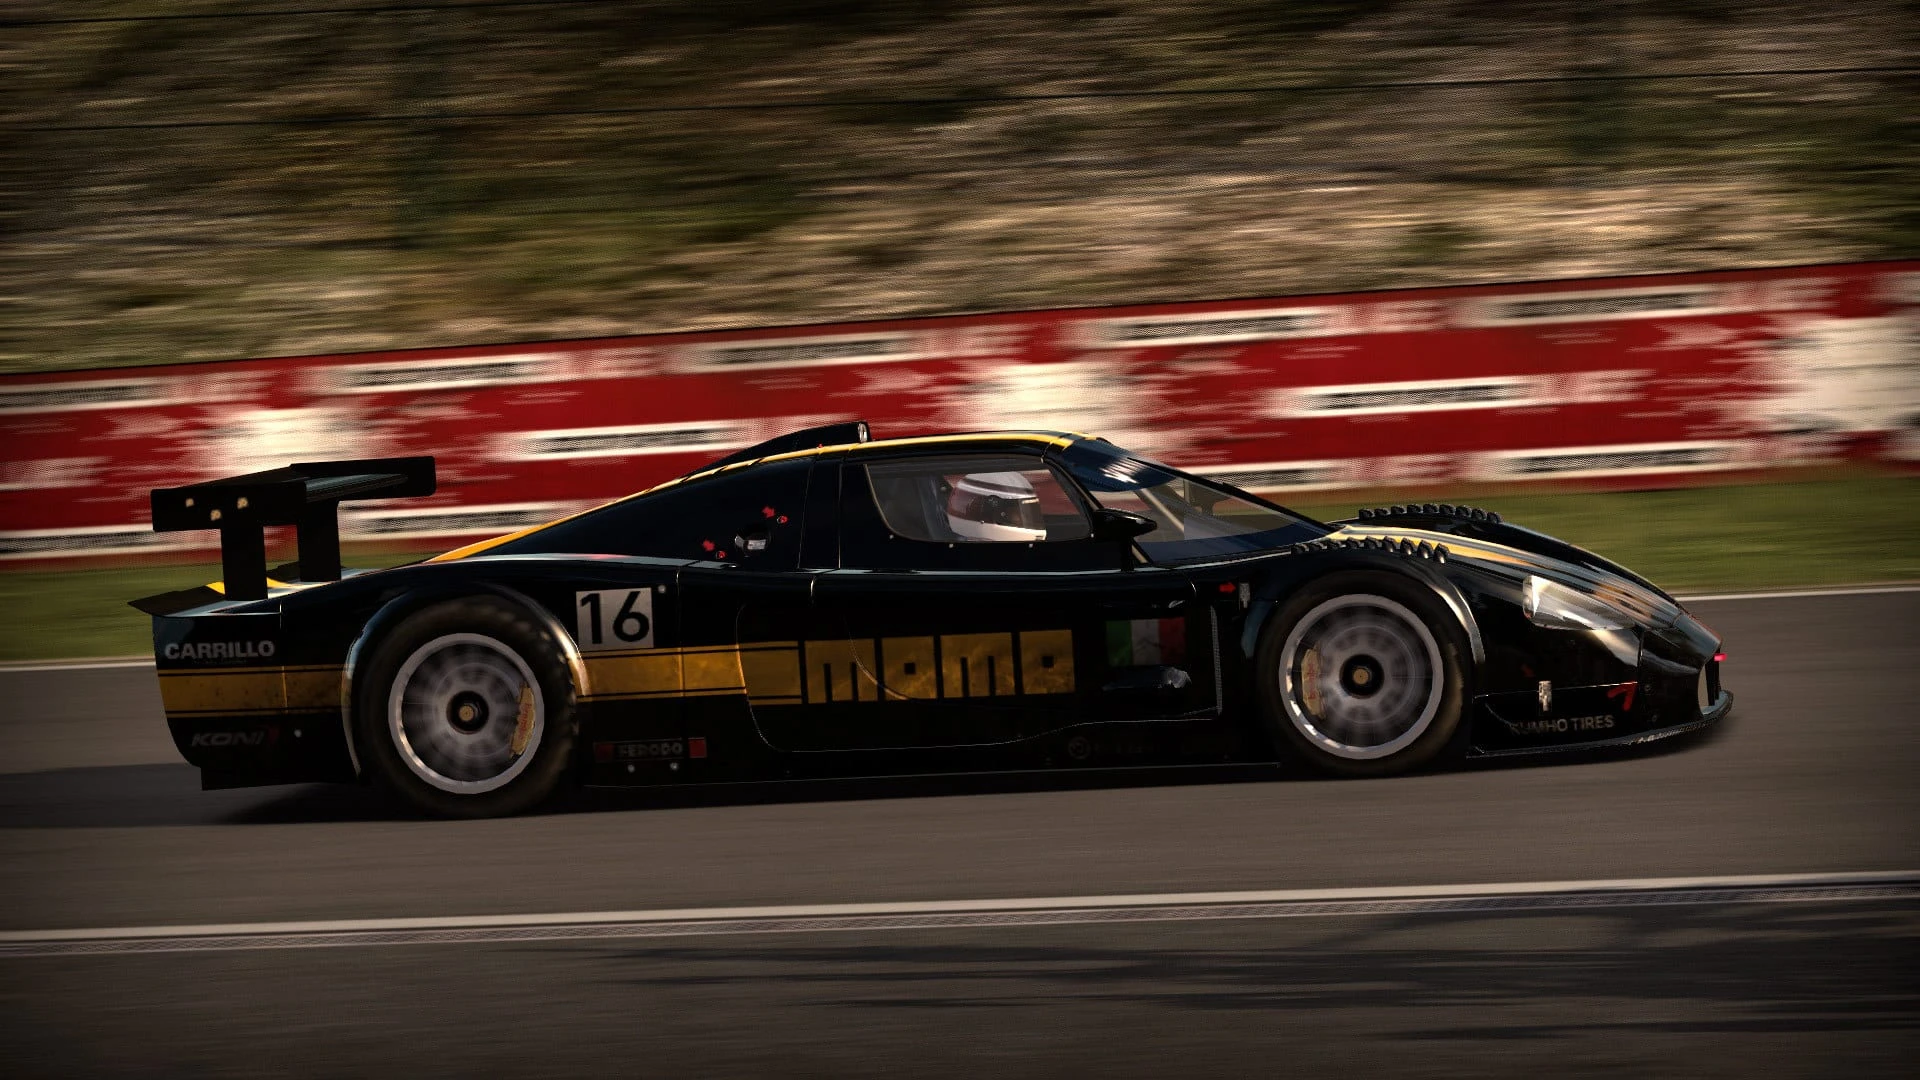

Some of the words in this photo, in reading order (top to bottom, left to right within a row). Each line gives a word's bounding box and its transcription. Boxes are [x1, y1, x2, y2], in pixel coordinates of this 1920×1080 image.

[580, 590, 650, 644] 16
[164, 639, 276, 660] CARRILLO
[1570, 713, 1618, 732] TIRES
[189, 730, 266, 747] KONI
